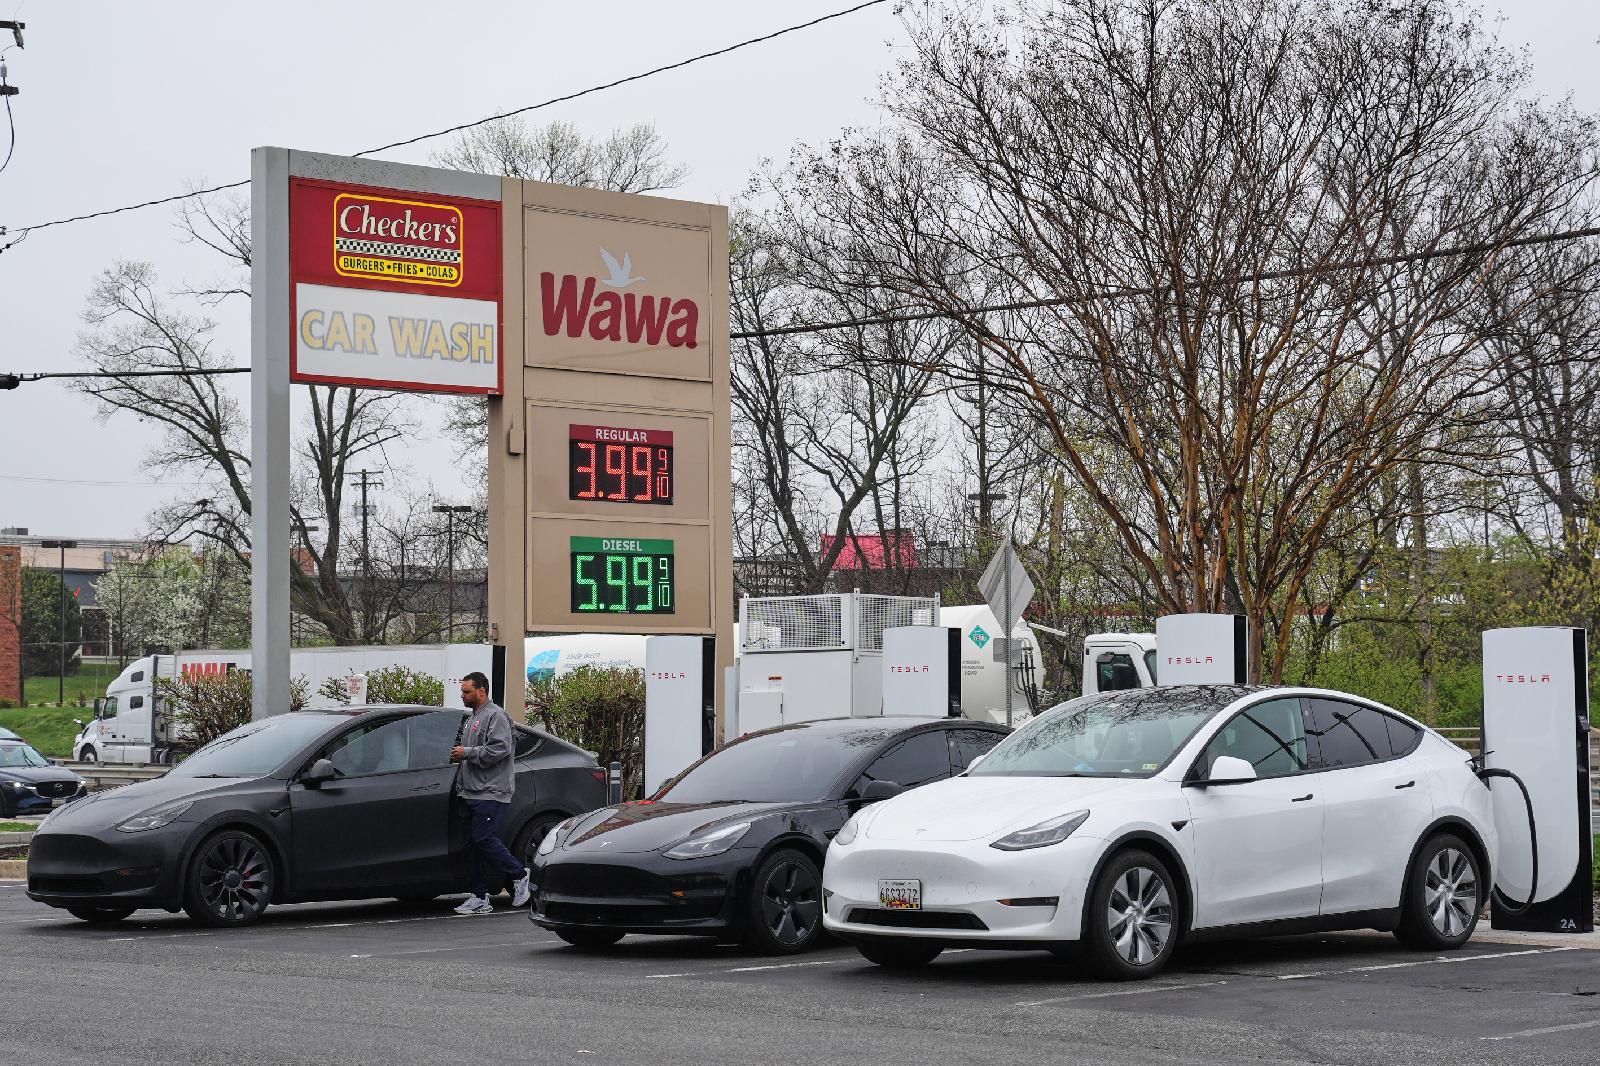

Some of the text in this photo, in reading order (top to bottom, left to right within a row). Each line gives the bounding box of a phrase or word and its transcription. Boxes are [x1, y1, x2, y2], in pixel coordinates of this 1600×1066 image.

[340, 204, 457, 244] Checkers
[343, 257, 454, 279] BURGERS FRIES COLAS
[540, 272, 699, 349] Wawa
[300, 309, 494, 364] CAR WASH
[595, 428, 648, 443] REGULAR
[602, 539, 643, 552] DIESEL
[1167, 656, 1213, 664] TESLA
[890, 665, 929, 673] TESLA
[651, 672, 686, 680] TESLA
[1496, 674, 1550, 683] TESLA
[1560, 918, 1577, 929] 2A
